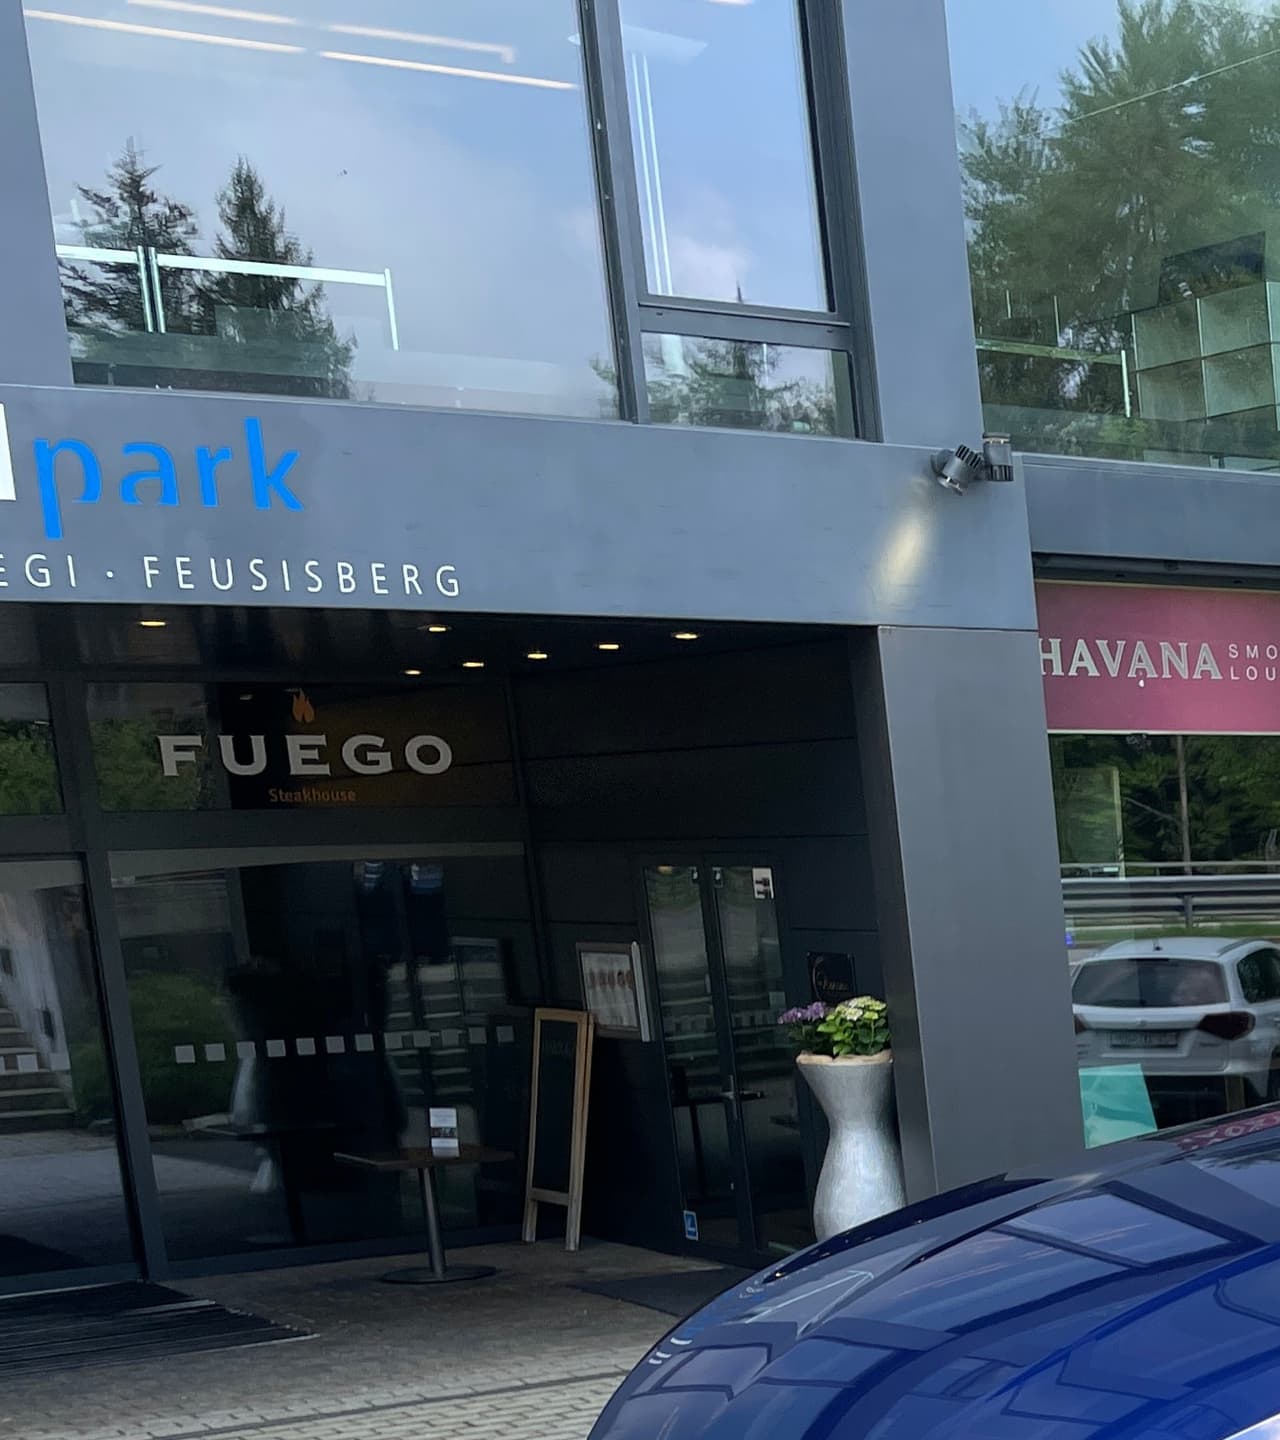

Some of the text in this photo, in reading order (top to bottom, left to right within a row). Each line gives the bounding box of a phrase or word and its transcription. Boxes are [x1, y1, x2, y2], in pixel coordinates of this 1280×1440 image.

[143, 555, 461, 598] FEUSISBERG
[1040, 637, 1222, 680] HAVANA
[157, 733, 453, 777] FUEGO
[268, 785, 357, 803] Steakhouse
